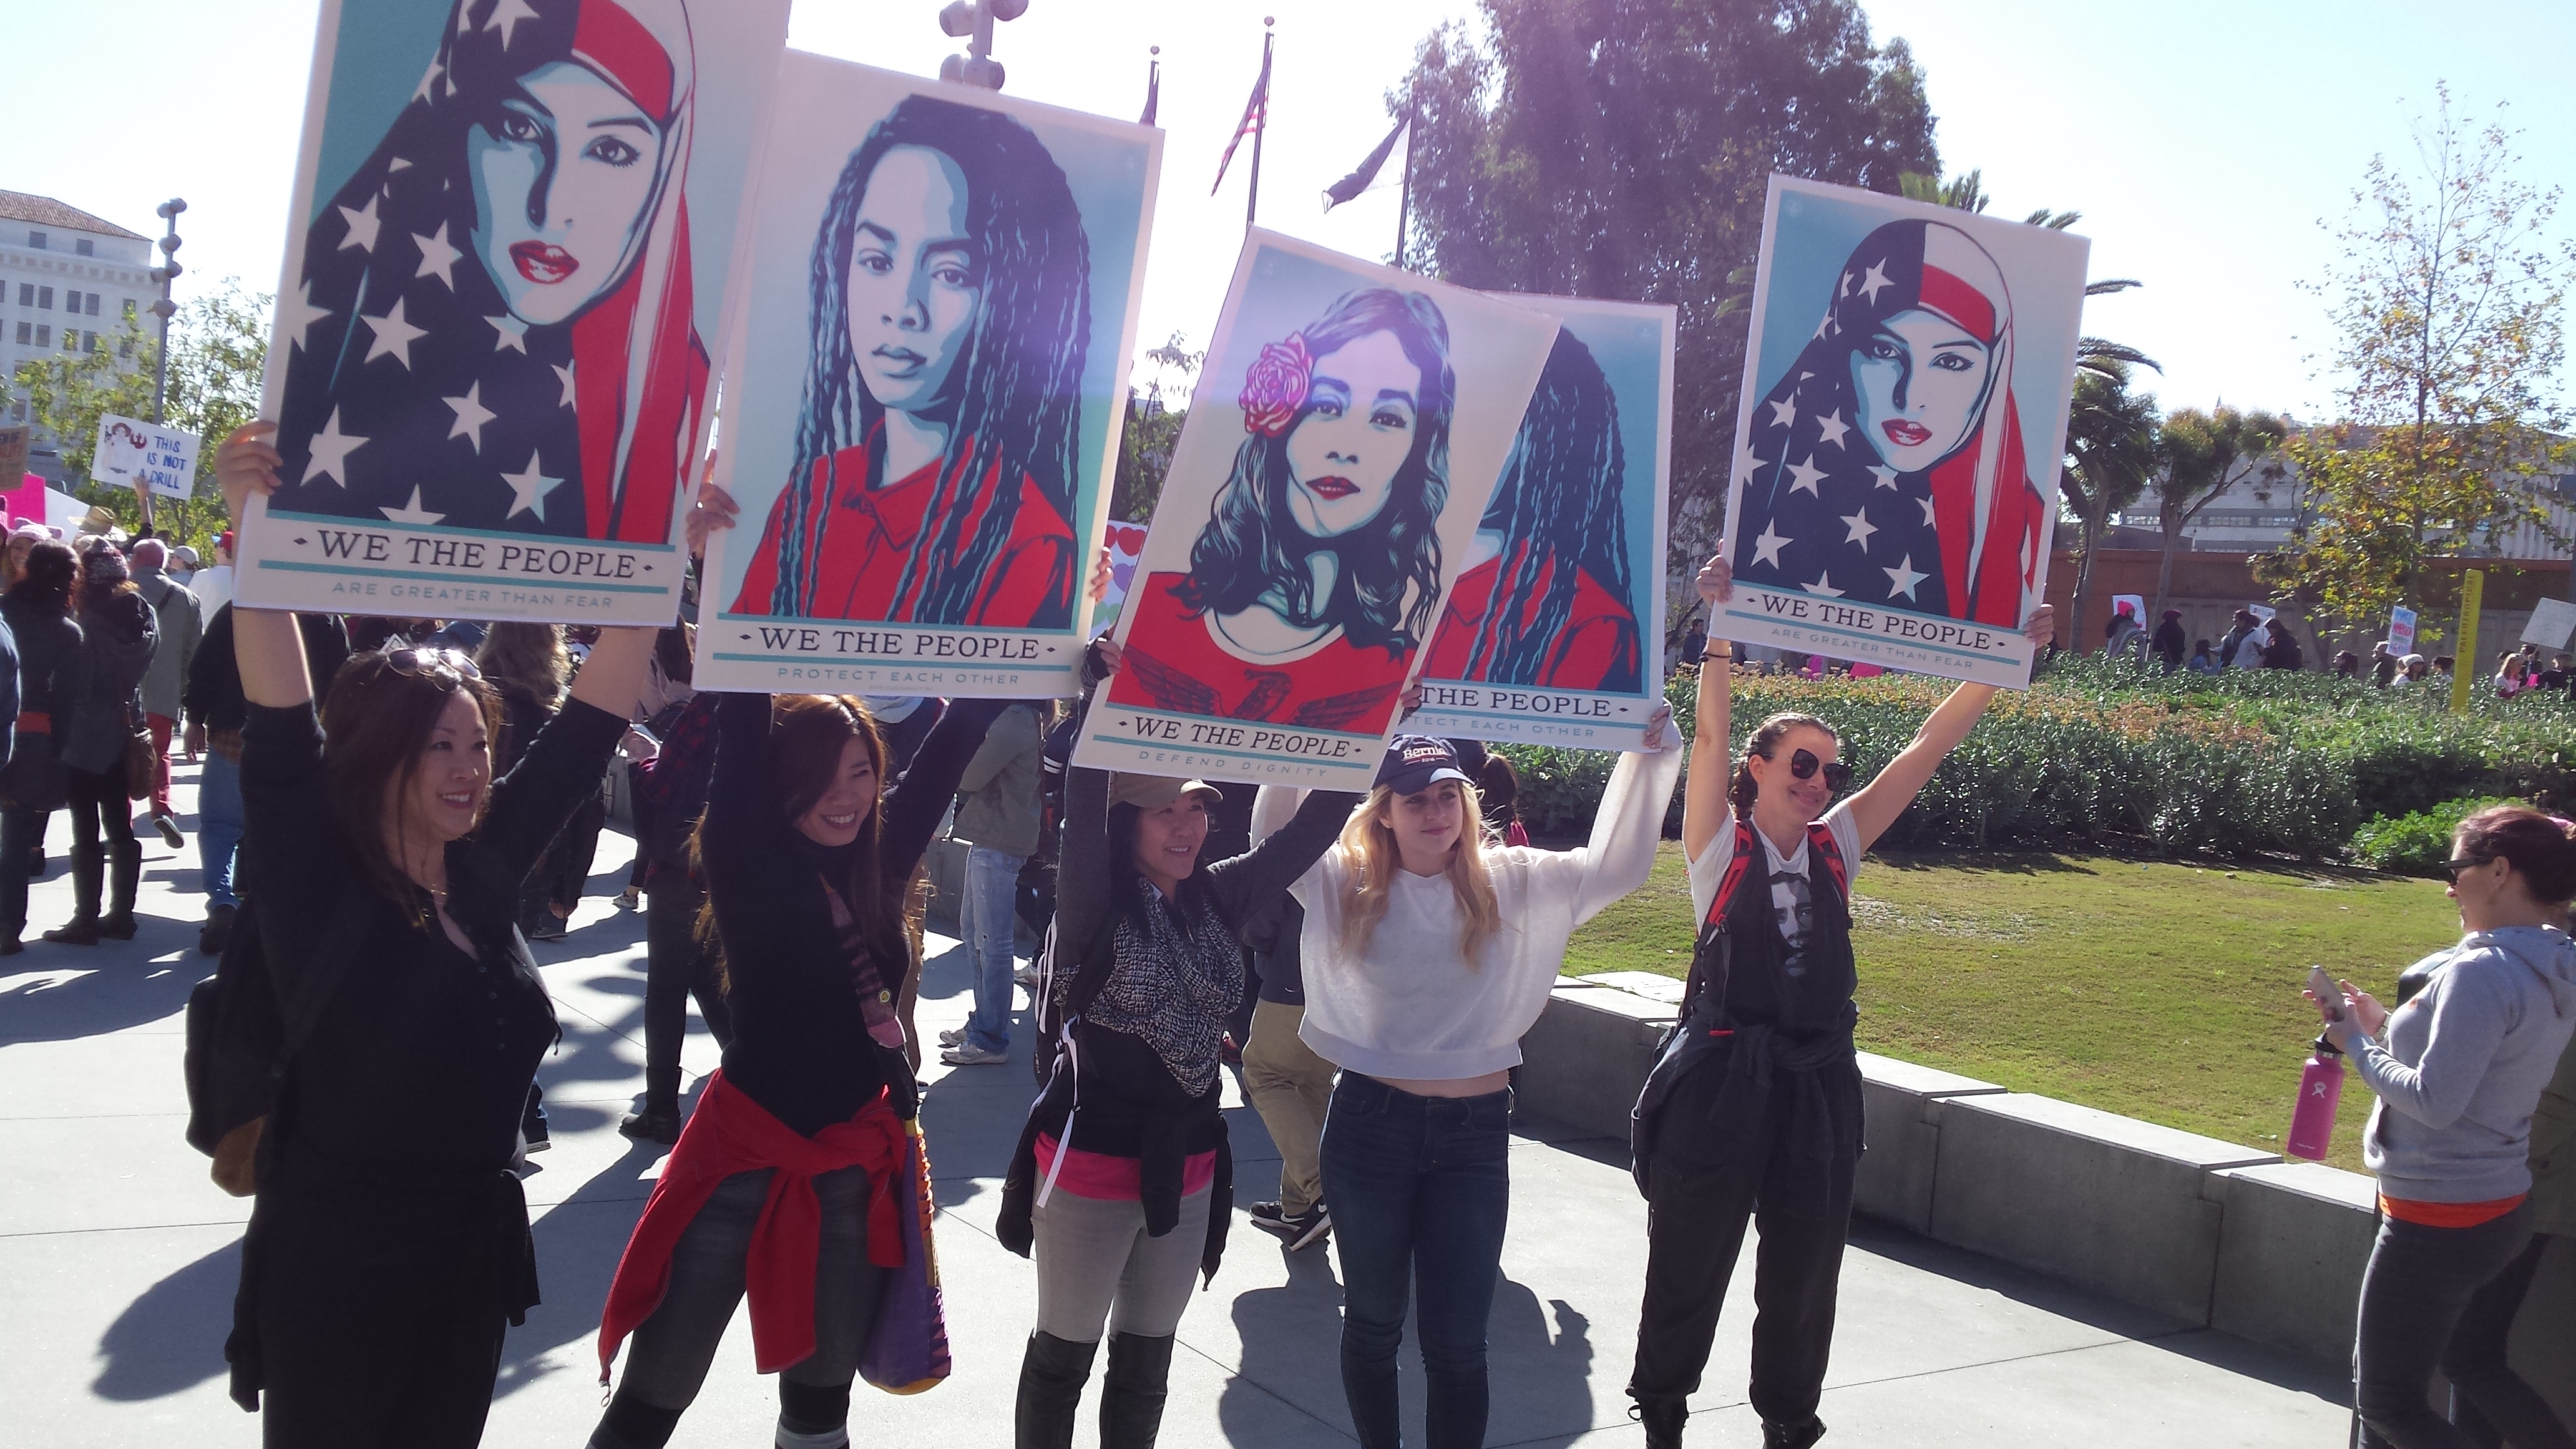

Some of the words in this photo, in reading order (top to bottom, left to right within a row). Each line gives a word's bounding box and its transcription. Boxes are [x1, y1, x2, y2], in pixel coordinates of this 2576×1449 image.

[154, 435, 181, 453] THIS
[147, 452, 157, 466] IS
[162, 454, 187, 471] NOT
[149, 470, 180, 490] DRILL
[316, 529, 391, 562] WE
[405, 537, 485, 568] THE
[498, 545, 637, 578] PEOPLE
[331, 582, 378, 596] ARE
[390, 584, 491, 602] GREATER
[500, 591, 555, 607] THAN
[564, 595, 613, 609] FEAR
[1760, 593, 1810, 618] WE
[1817, 603, 1875, 630] THE
[1883, 615, 1991, 650] PEOPLE
[758, 627, 821, 651] WE
[832, 630, 904, 655] THE
[915, 635, 1040, 660] PEOPLE
[1772, 628, 1802, 640] ARE
[1810, 634, 1880, 653] GREATER
[1886, 647, 1927, 661] THAN
[1934, 655, 1974, 670] FEAR
[778, 668, 877, 681] PROTECT
[890, 671, 944, 684] EACH
[955, 674, 1019, 685] OTHER
[1422, 686, 1480, 707] THE
[1490, 691, 1611, 718] PEOPLE
[1134, 716, 1182, 739] WE
[1189, 723, 1244, 747] THE
[1249, 730, 1350, 758] PEOPLE
[1471, 720, 1520, 731] EACH
[1532, 725, 1595, 738] OTHER
[1139, 751, 1226, 768] DEFEND
[1241, 761, 1328, 777] DIGNITY
[1402, 746, 1449, 760] Bernie
